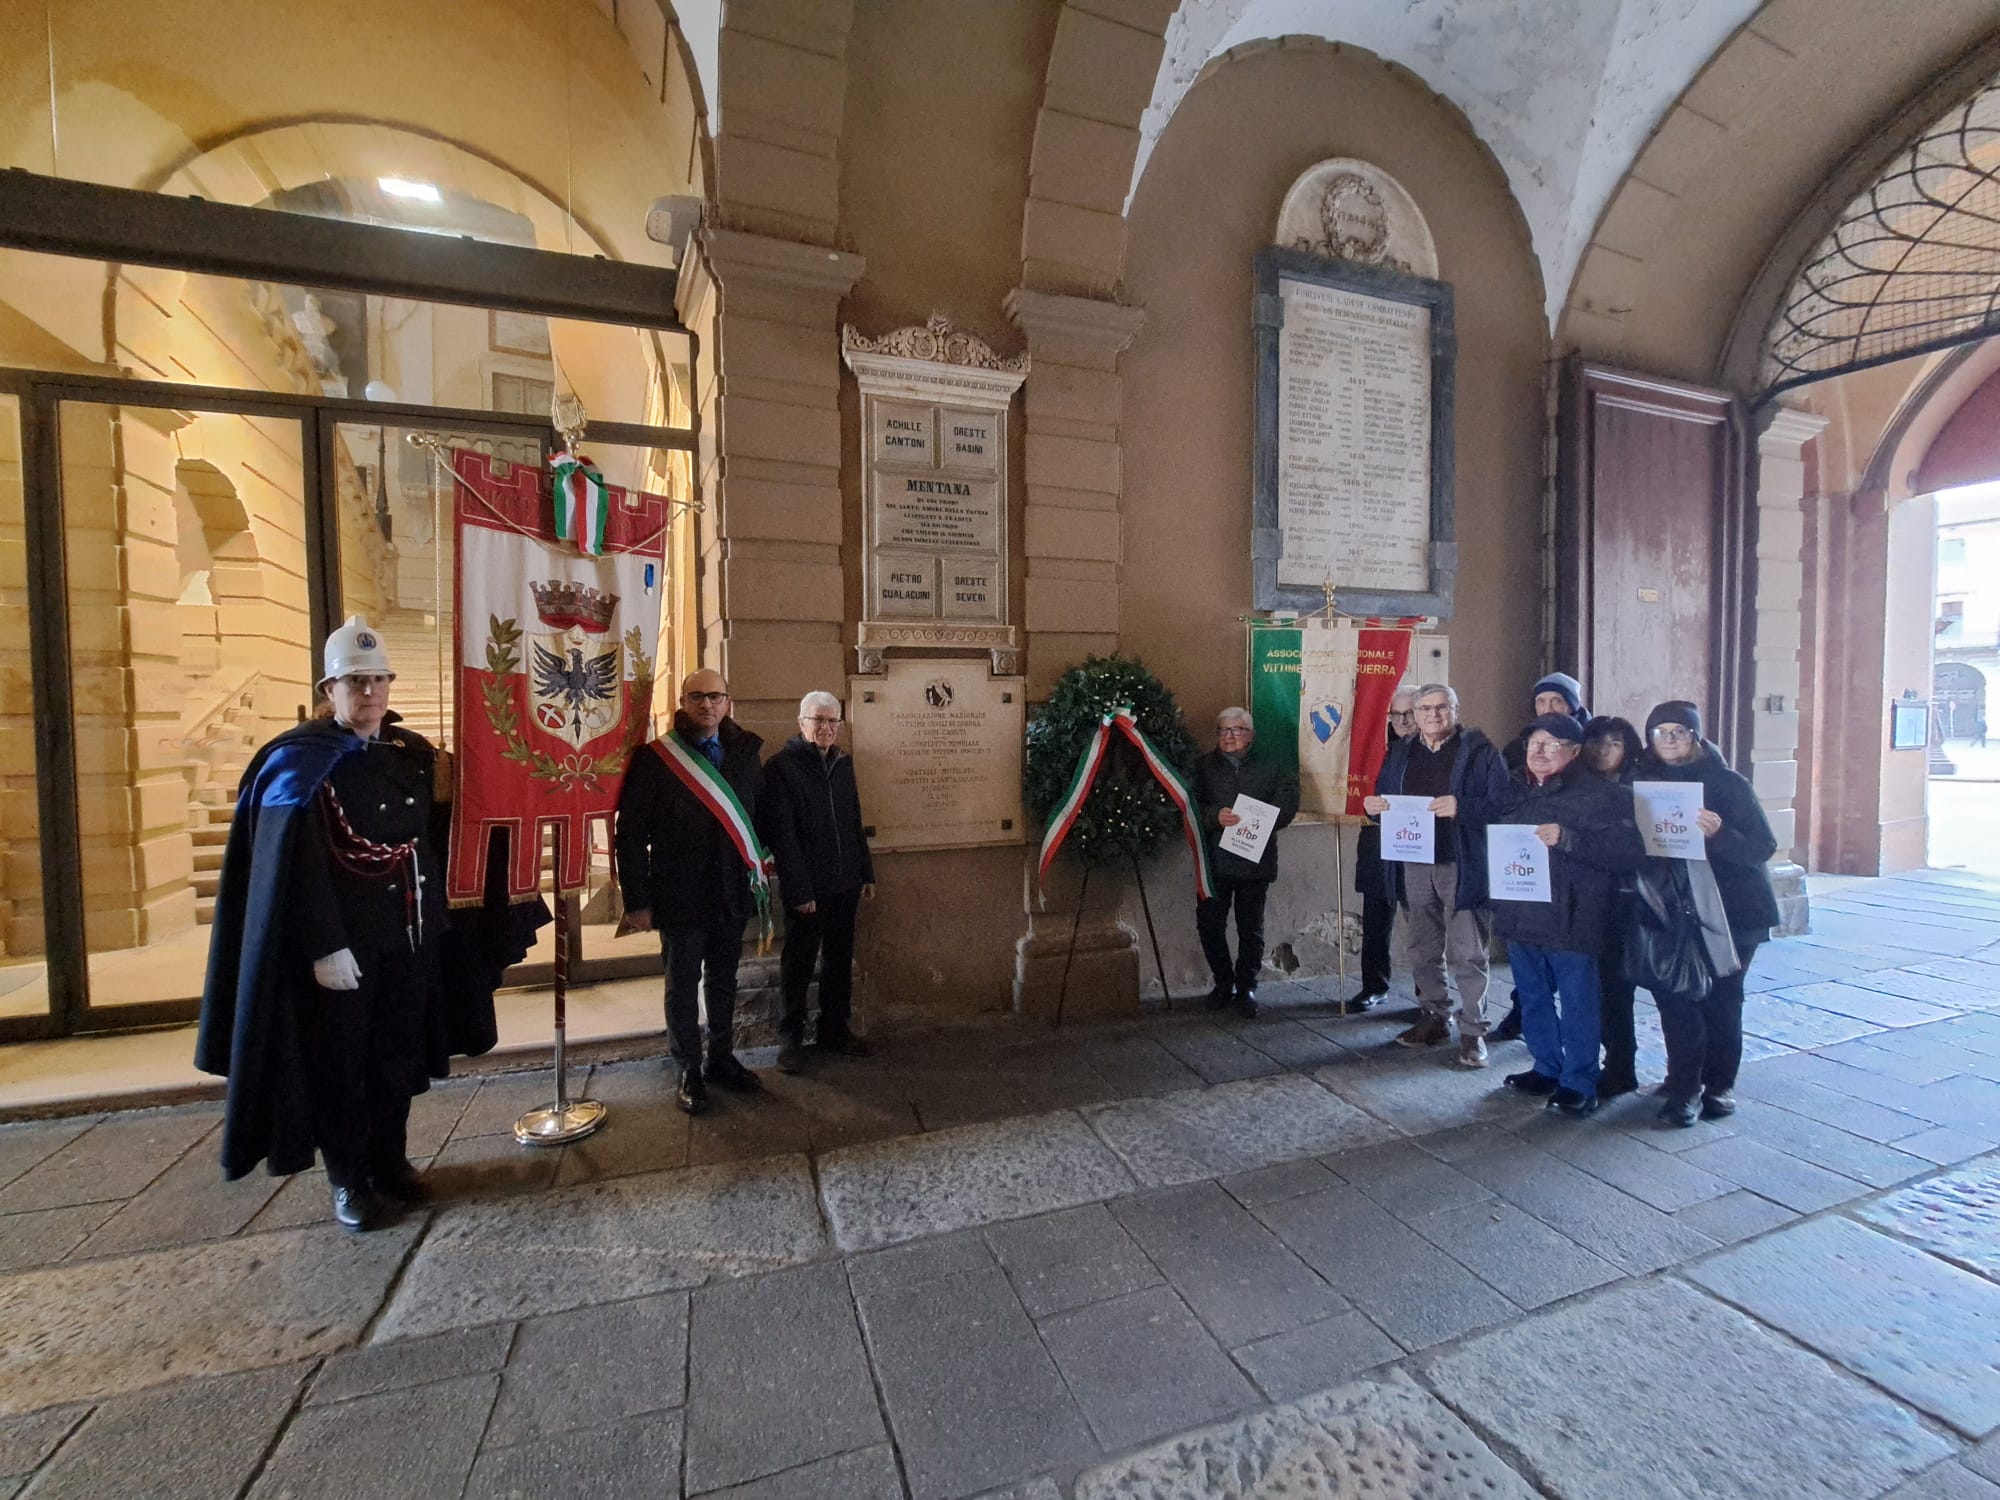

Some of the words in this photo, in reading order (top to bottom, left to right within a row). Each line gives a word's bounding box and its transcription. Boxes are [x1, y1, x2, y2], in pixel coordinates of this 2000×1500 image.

[886, 419, 922, 432] ACHILLE
[953, 426, 986, 439] ORESTE
[885, 437, 925, 449] CANTONI
[956, 443, 983, 455] BASINI
[906, 479, 971, 496] MENTANA
[890, 573, 922, 584] PIETRO
[954, 576, 987, 587] ORESTE
[956, 592, 986, 602] SEVERI
[1353, 664, 1397, 676] GUERRA
[1655, 818, 1688, 834] STOP
[1236, 825, 1258, 841] STOP
[1396, 827, 1422, 841] STOP
[1504, 861, 1535, 877] STOP
